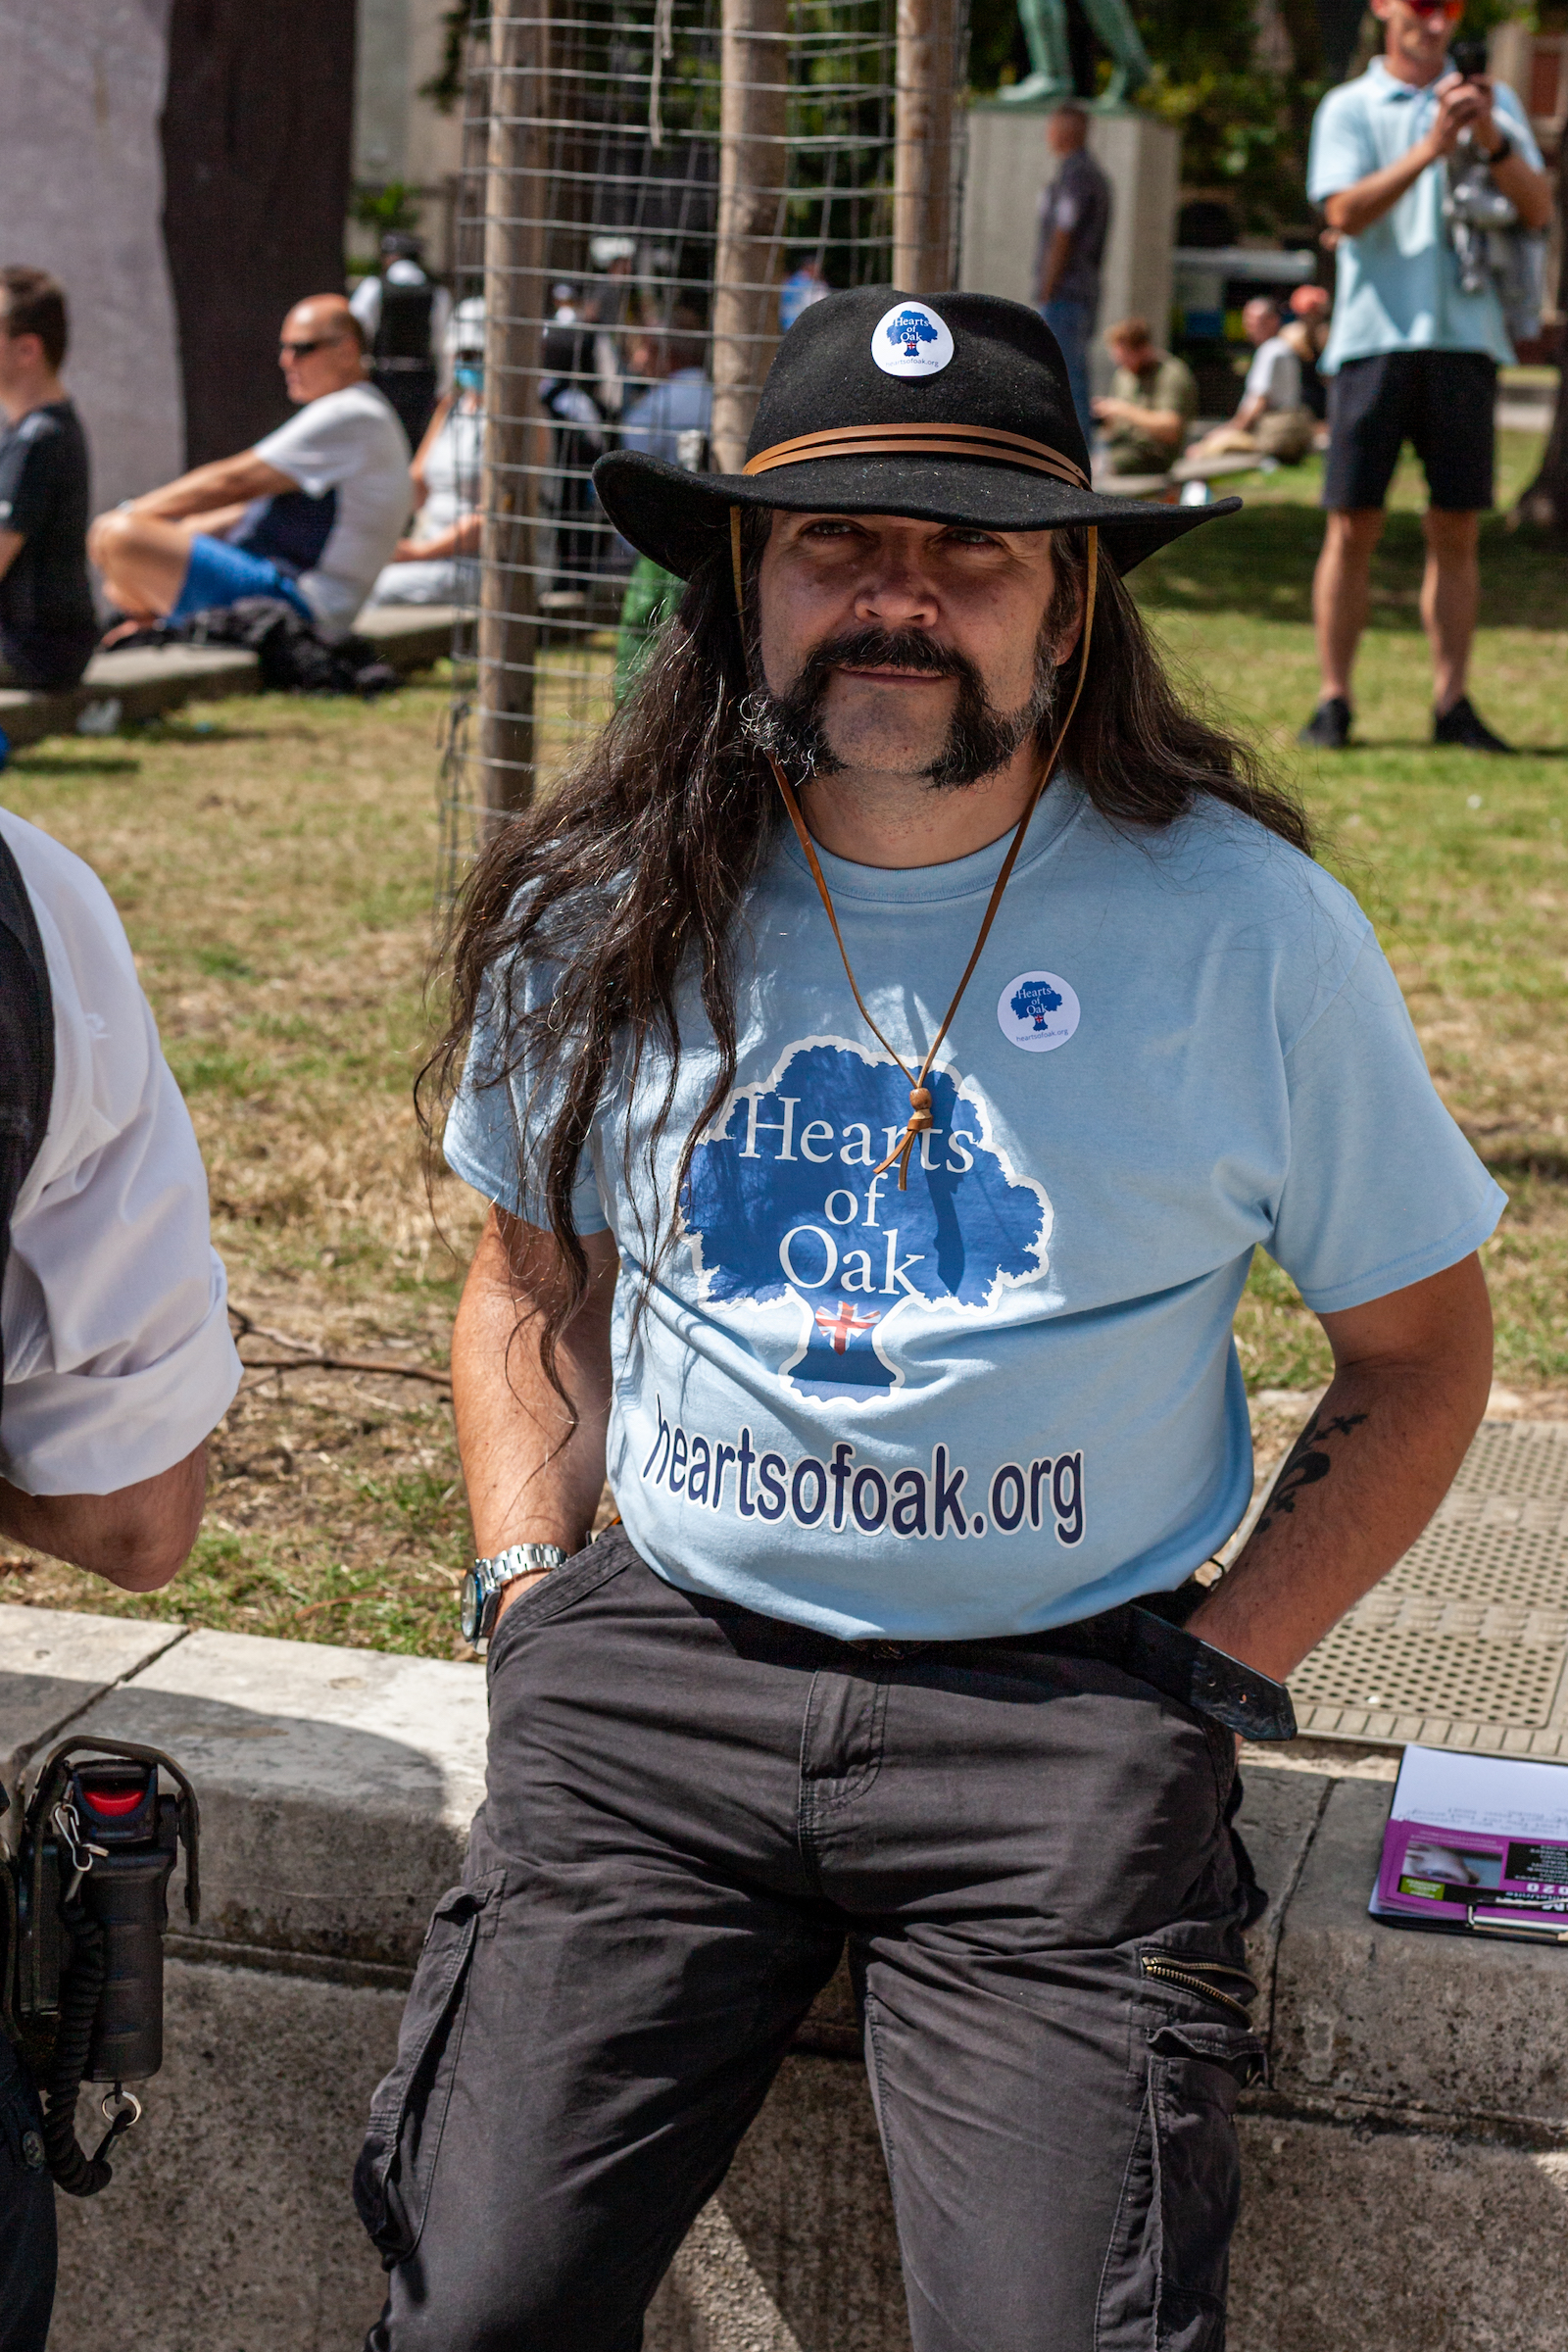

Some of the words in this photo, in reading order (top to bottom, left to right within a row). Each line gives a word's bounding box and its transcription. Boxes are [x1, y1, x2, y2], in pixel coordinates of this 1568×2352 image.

[895, 317, 929, 326] Hearts
[906, 324, 917, 333] of
[900, 331, 922, 342] Oak
[886, 358, 939, 368] heartsofoak.org
[1017, 987, 1052, 999] Hearts
[1026, 1003, 1048, 1015] Oak
[1016, 1029, 1069, 1042] heartsofoak.org
[738, 1094, 975, 1174] Hearts
[823, 1171, 889, 1228] of
[778, 1224, 926, 1298] Oak
[642, 1392, 1084, 1545] heartsofoak.org
